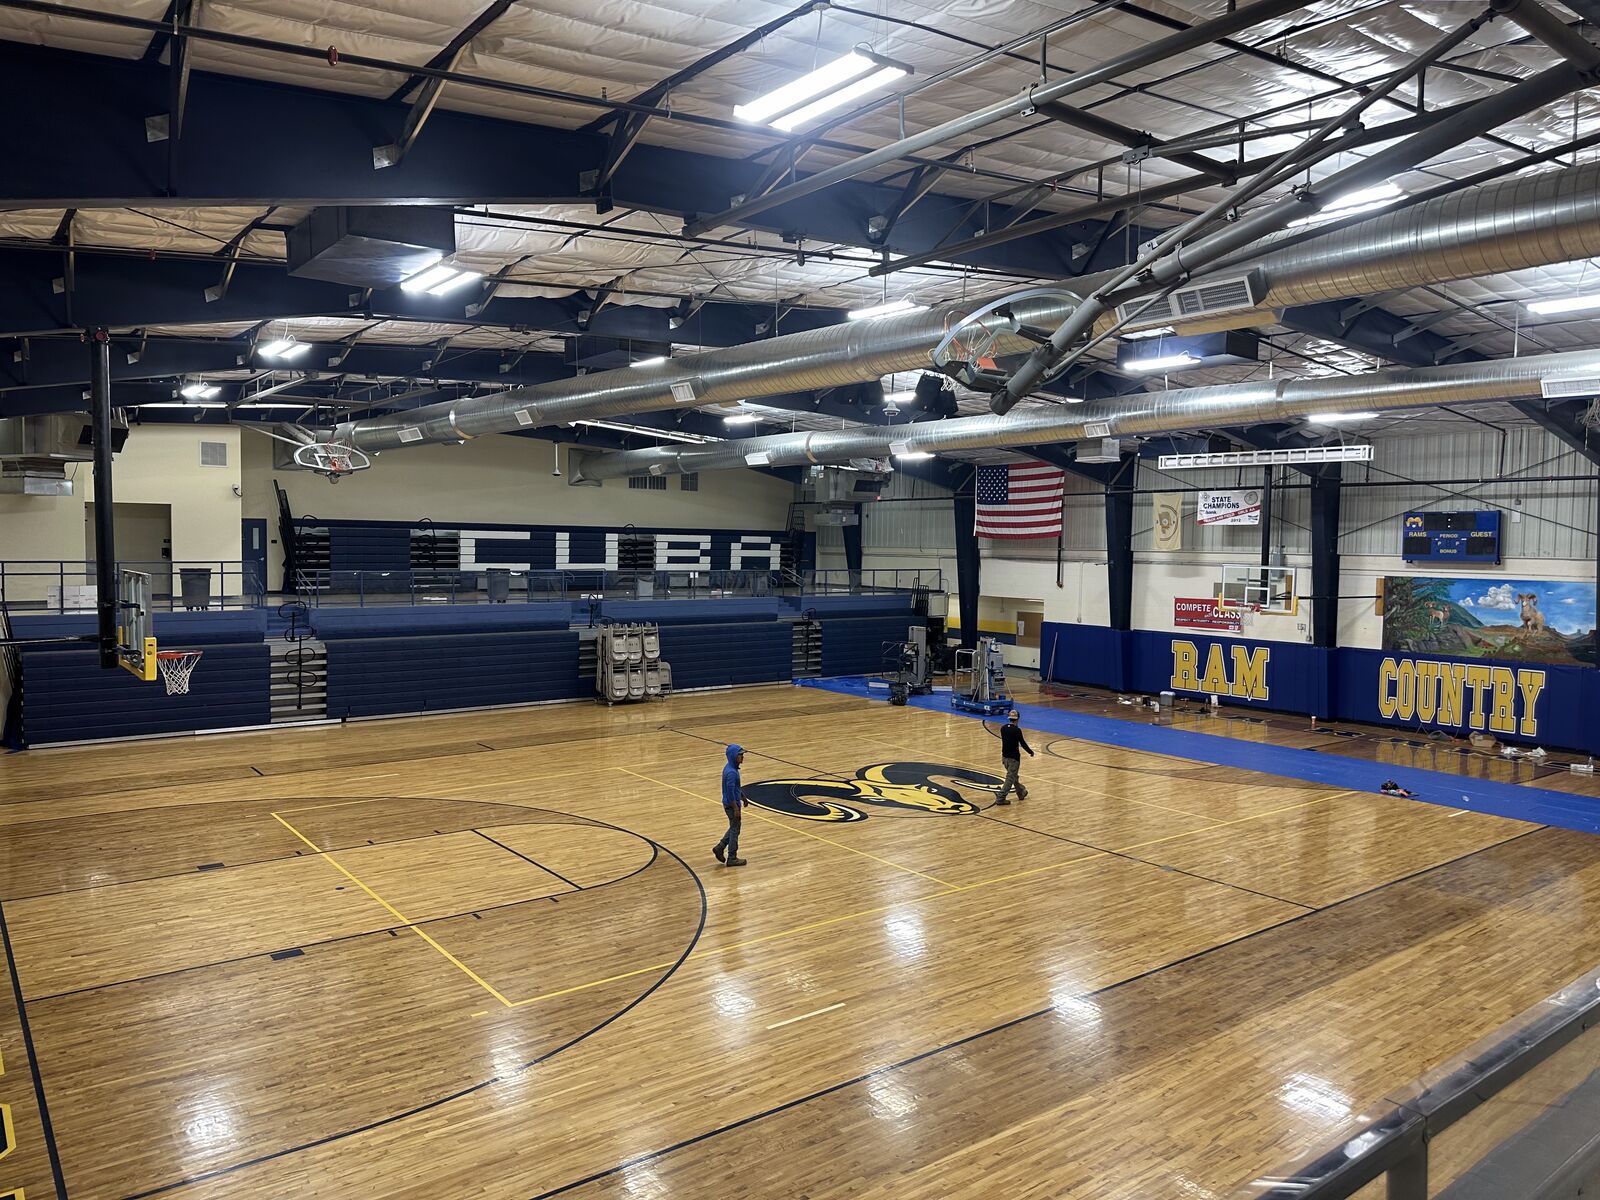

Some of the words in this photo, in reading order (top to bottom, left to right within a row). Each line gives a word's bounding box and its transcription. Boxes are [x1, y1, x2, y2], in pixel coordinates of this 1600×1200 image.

[460, 530, 781, 571] CUBA
[1175, 603, 1211, 612] COMPETE
[1212, 606, 1241, 619] CLASS
[1171, 640, 1270, 701] RAM
[1379, 657, 1546, 737] COUNTRY
